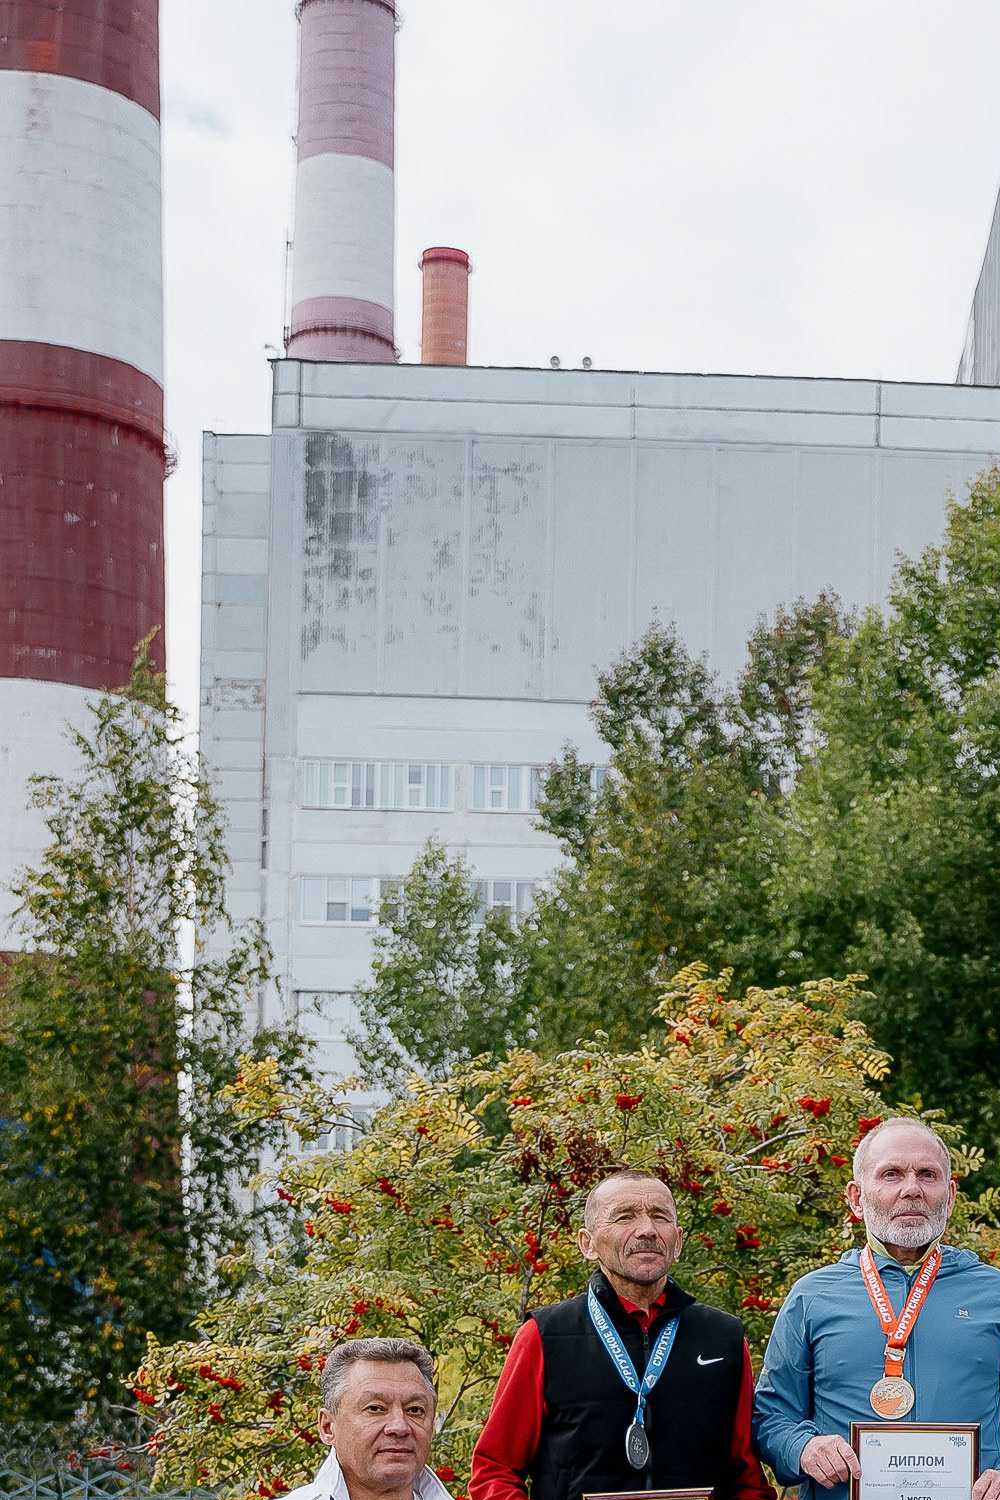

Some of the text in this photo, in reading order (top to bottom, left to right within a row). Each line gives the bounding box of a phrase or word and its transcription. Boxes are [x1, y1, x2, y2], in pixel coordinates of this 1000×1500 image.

[866, 1271, 893, 1323] СУРГУТСКОЕ
[894, 1286, 925, 1340] СУРГУТСКОЕ
[603, 1331, 636, 1388] СУРГУТСКОЕ
[888, 1455, 945, 1468] ДИПЛОМ
